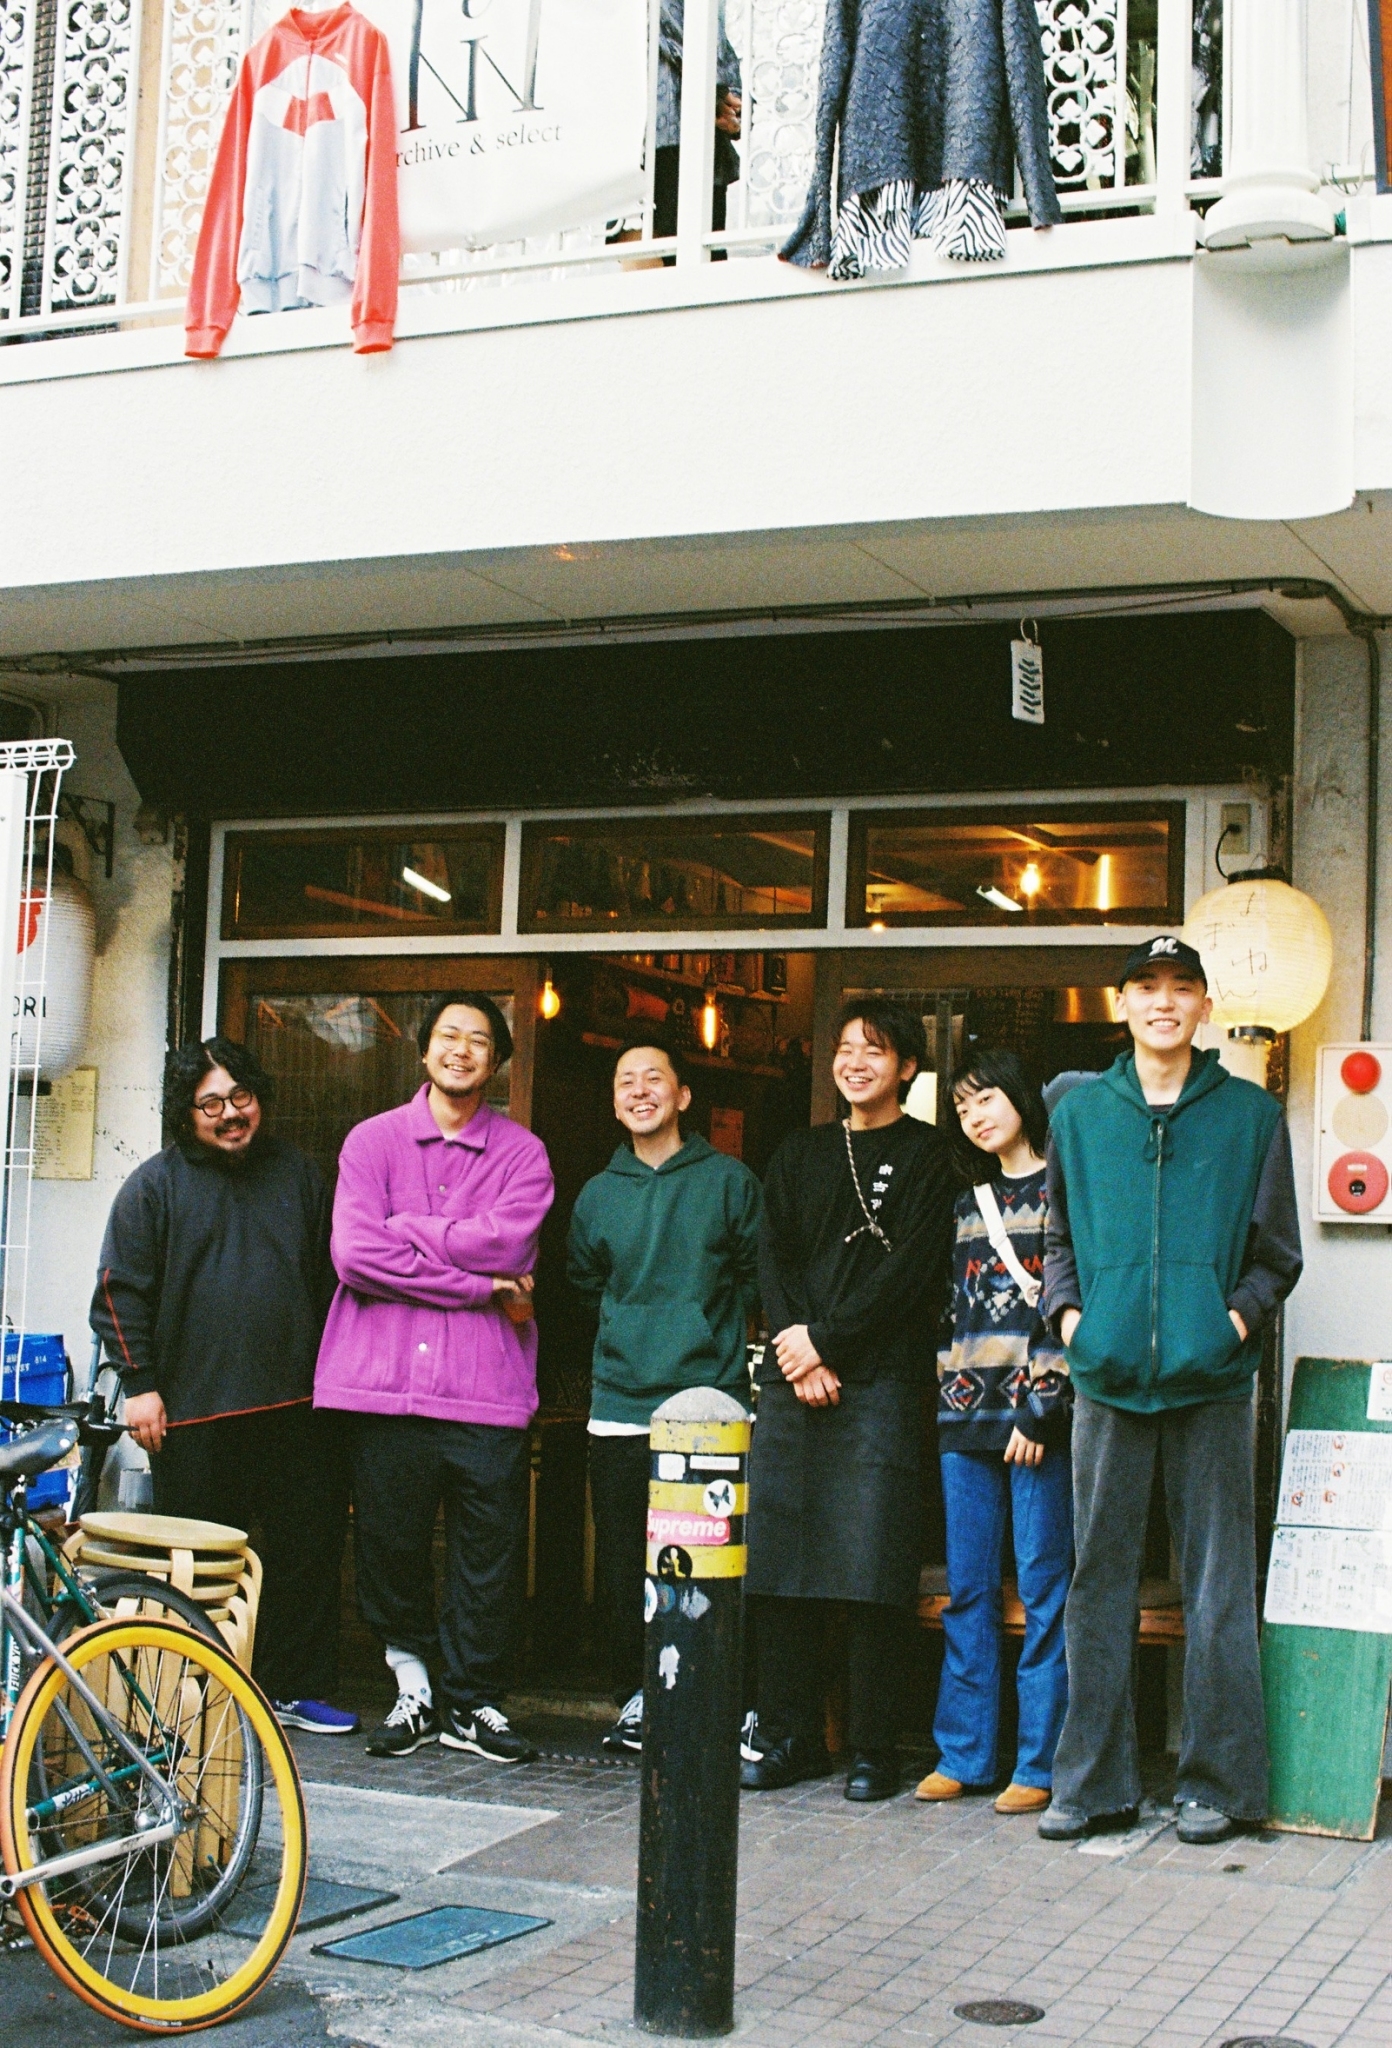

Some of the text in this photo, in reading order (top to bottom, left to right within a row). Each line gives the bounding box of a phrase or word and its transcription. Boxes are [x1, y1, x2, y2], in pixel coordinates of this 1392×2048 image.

[396, 123, 563, 168] rchive & select
